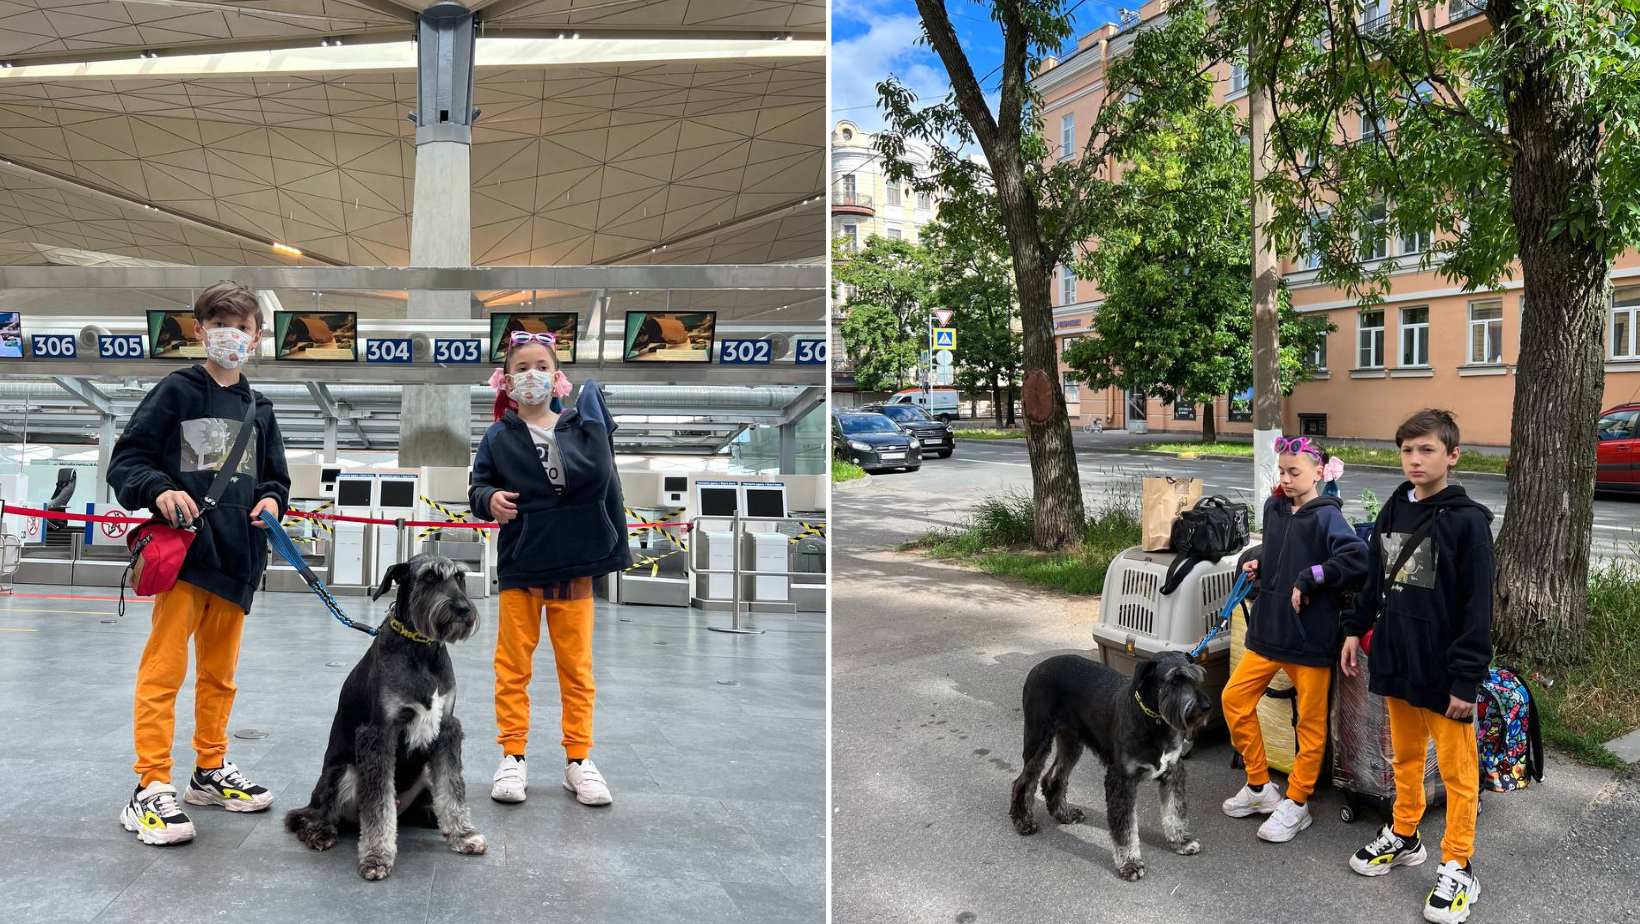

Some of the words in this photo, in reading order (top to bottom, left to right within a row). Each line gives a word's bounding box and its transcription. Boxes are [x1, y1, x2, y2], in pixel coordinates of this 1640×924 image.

[34, 337, 75, 356] 306
[101, 337, 141, 356] 305
[368, 341, 409, 360] 304
[436, 341, 478, 361] 303
[723, 341, 769, 362] 302
